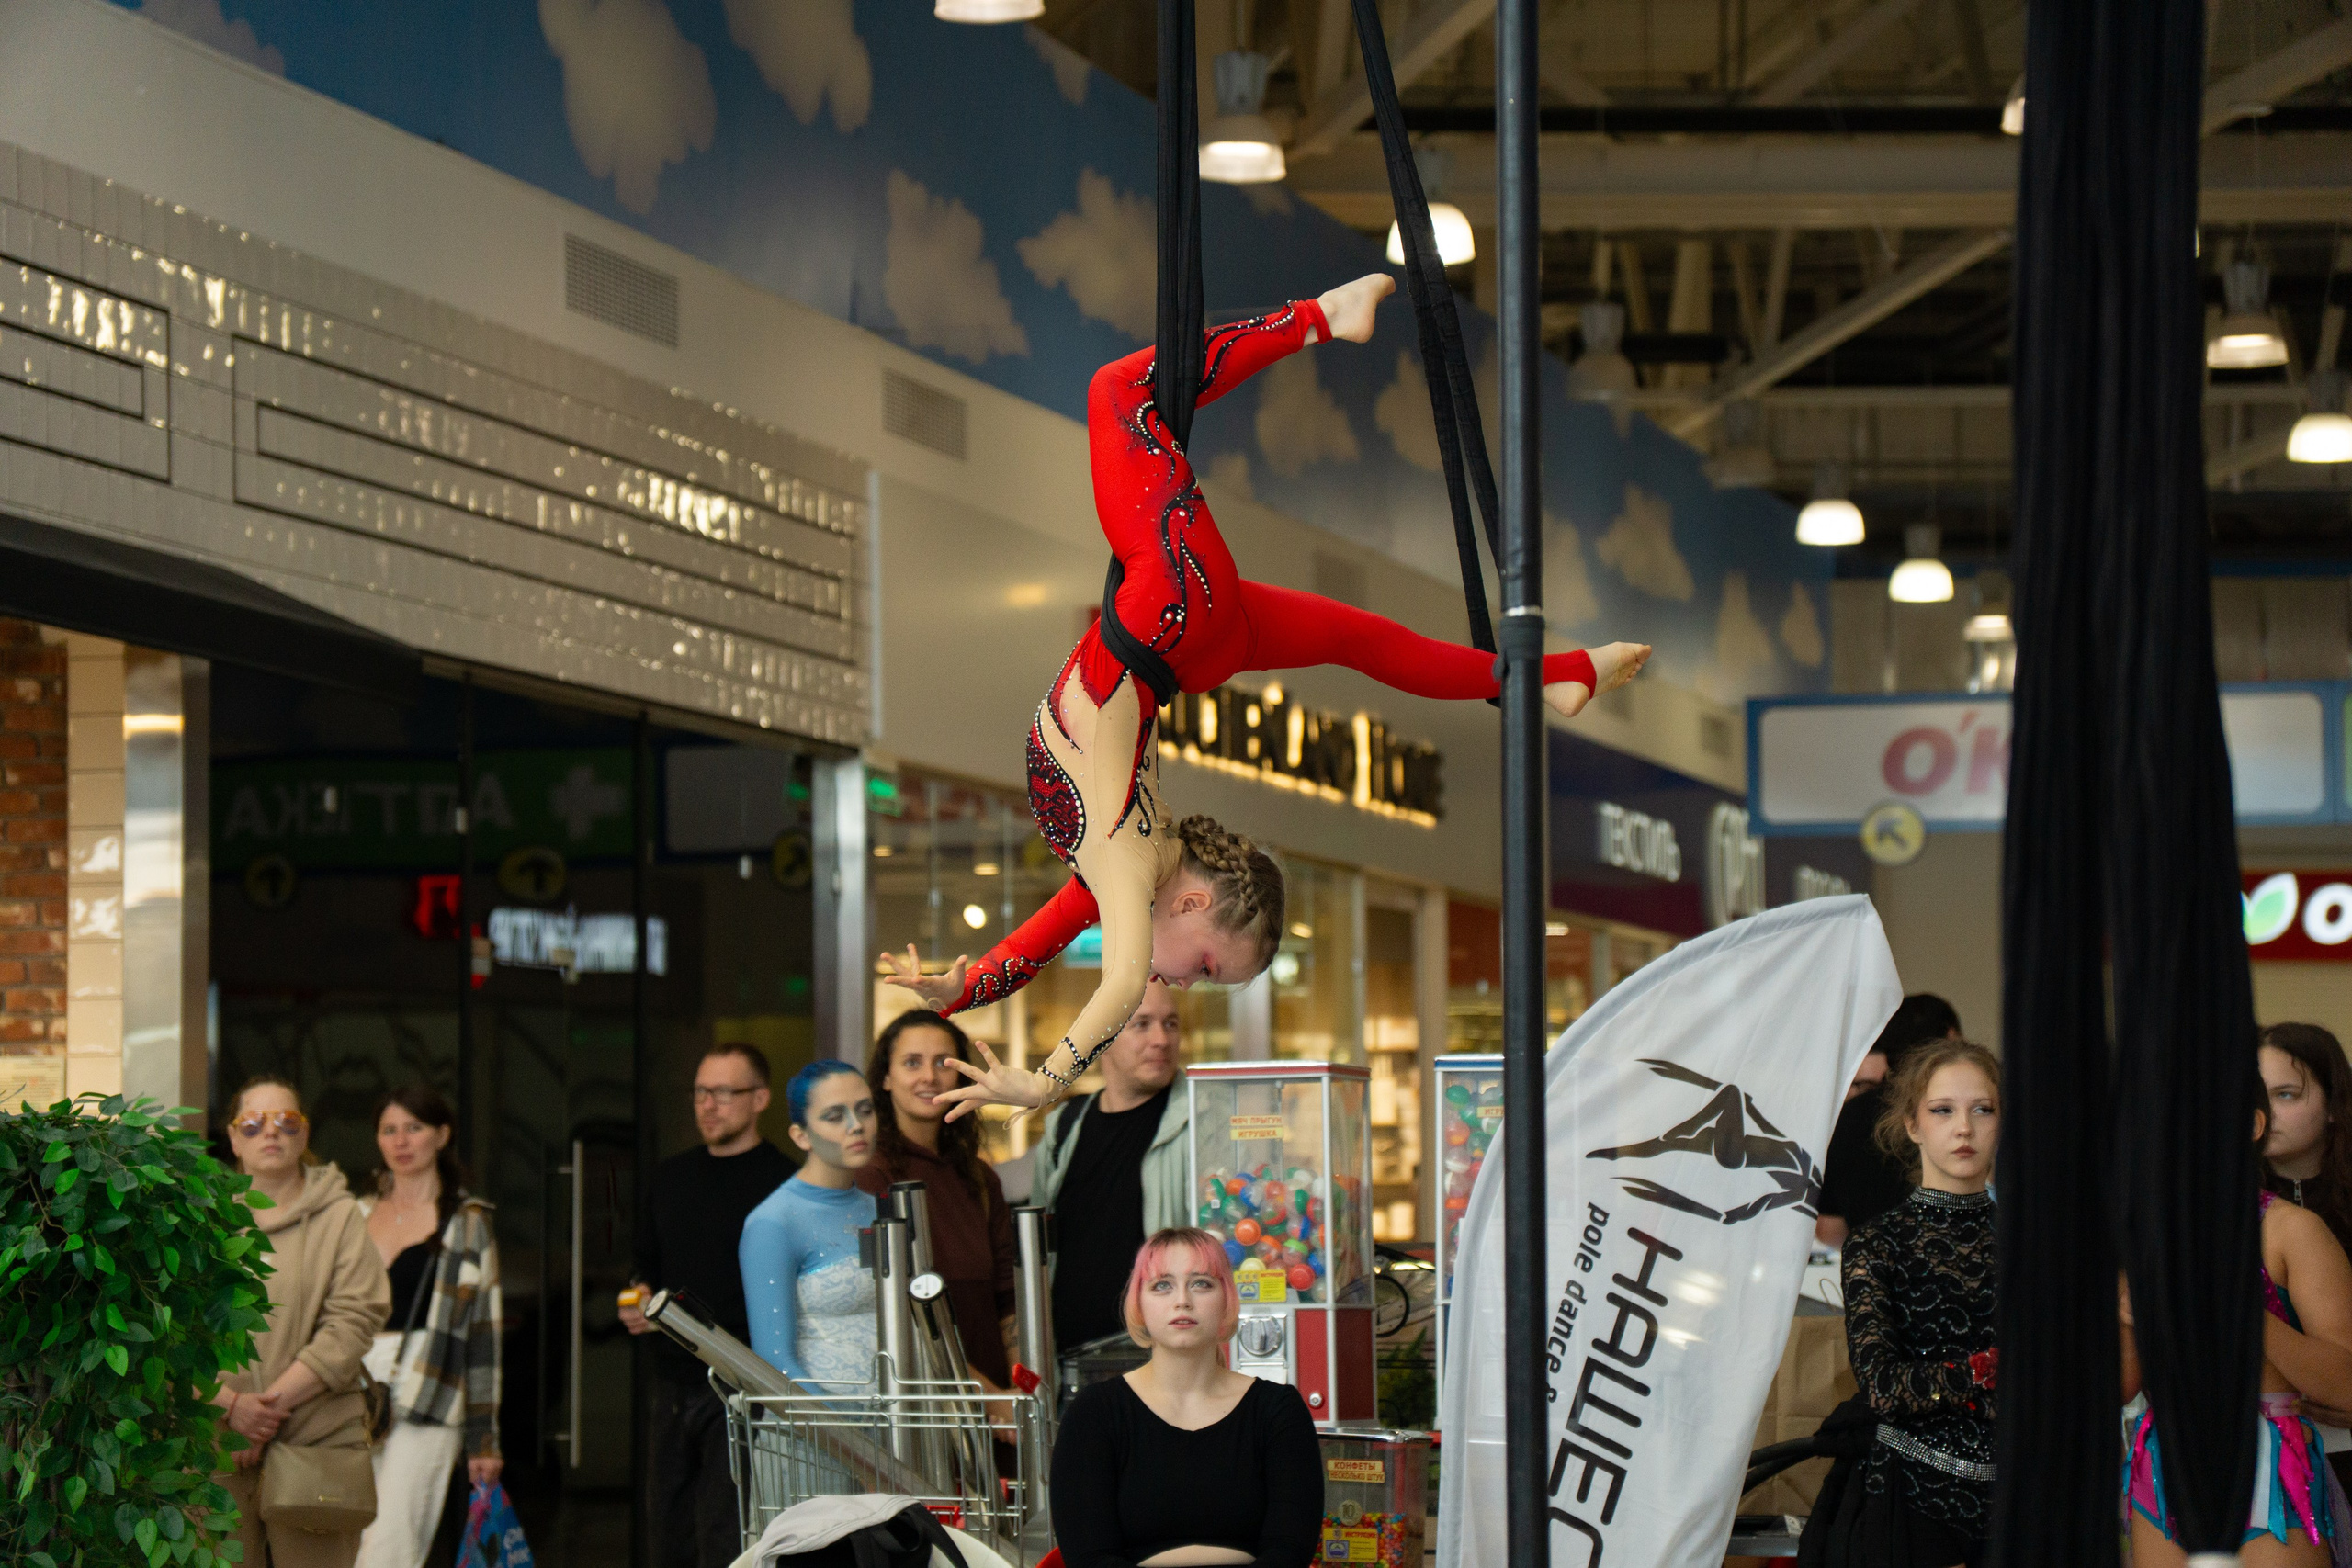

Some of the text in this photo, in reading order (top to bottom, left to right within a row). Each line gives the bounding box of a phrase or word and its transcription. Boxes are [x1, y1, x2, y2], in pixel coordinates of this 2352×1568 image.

[1238, 1129, 1277, 1138] ИГРУШКА
[1574, 1201, 1611, 1274] pole
[1546, 1280, 1588, 1374] dance
[1334, 1461, 1375, 1471] КОНФЕТЫ
[1330, 1472, 1385, 1482] НЕСКОЛЬКО ШТУК
[1340, 1503, 1356, 1518] 10
